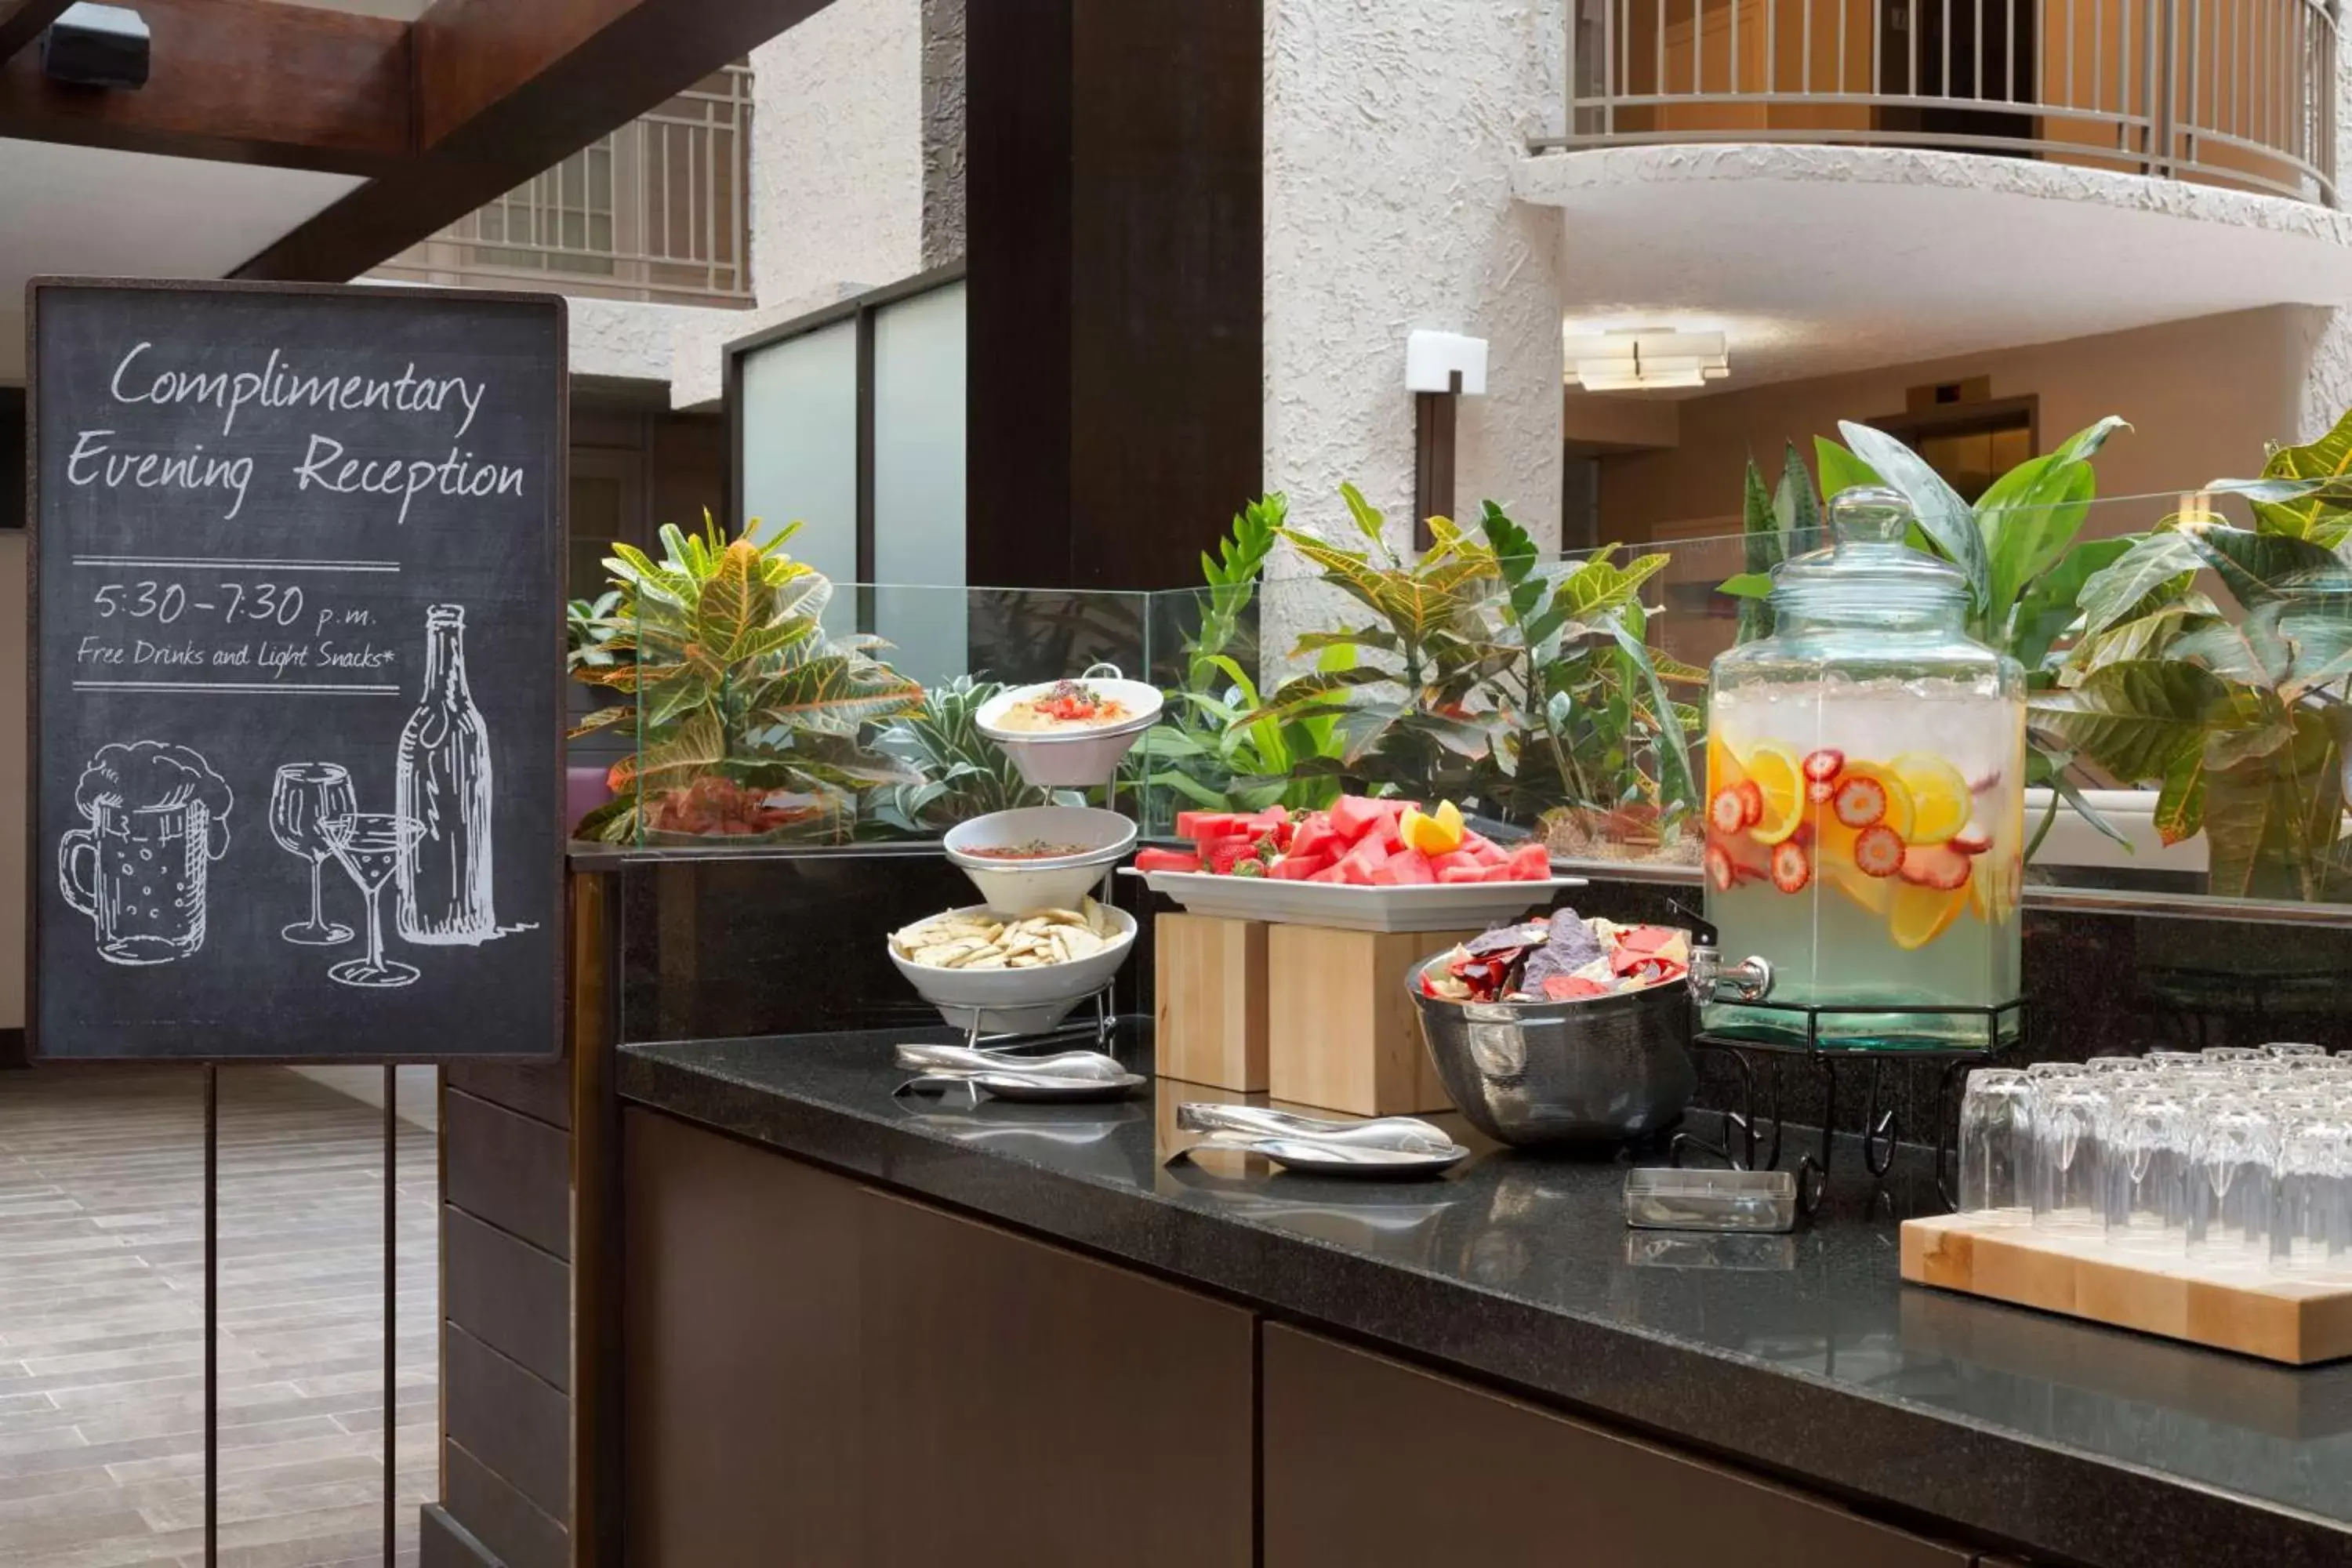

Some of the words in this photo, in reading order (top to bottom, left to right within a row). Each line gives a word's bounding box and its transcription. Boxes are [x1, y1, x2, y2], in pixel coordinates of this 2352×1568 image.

[111, 342, 485, 437] Complimentary
[67, 430, 253, 520] Evening
[292, 434, 524, 524] Reception
[316, 608, 376, 637] p.m.
[78, 636, 124, 663] Free
[134, 640, 204, 665] Drinks
[212, 644, 250, 665] and
[258, 641, 308, 678] Light
